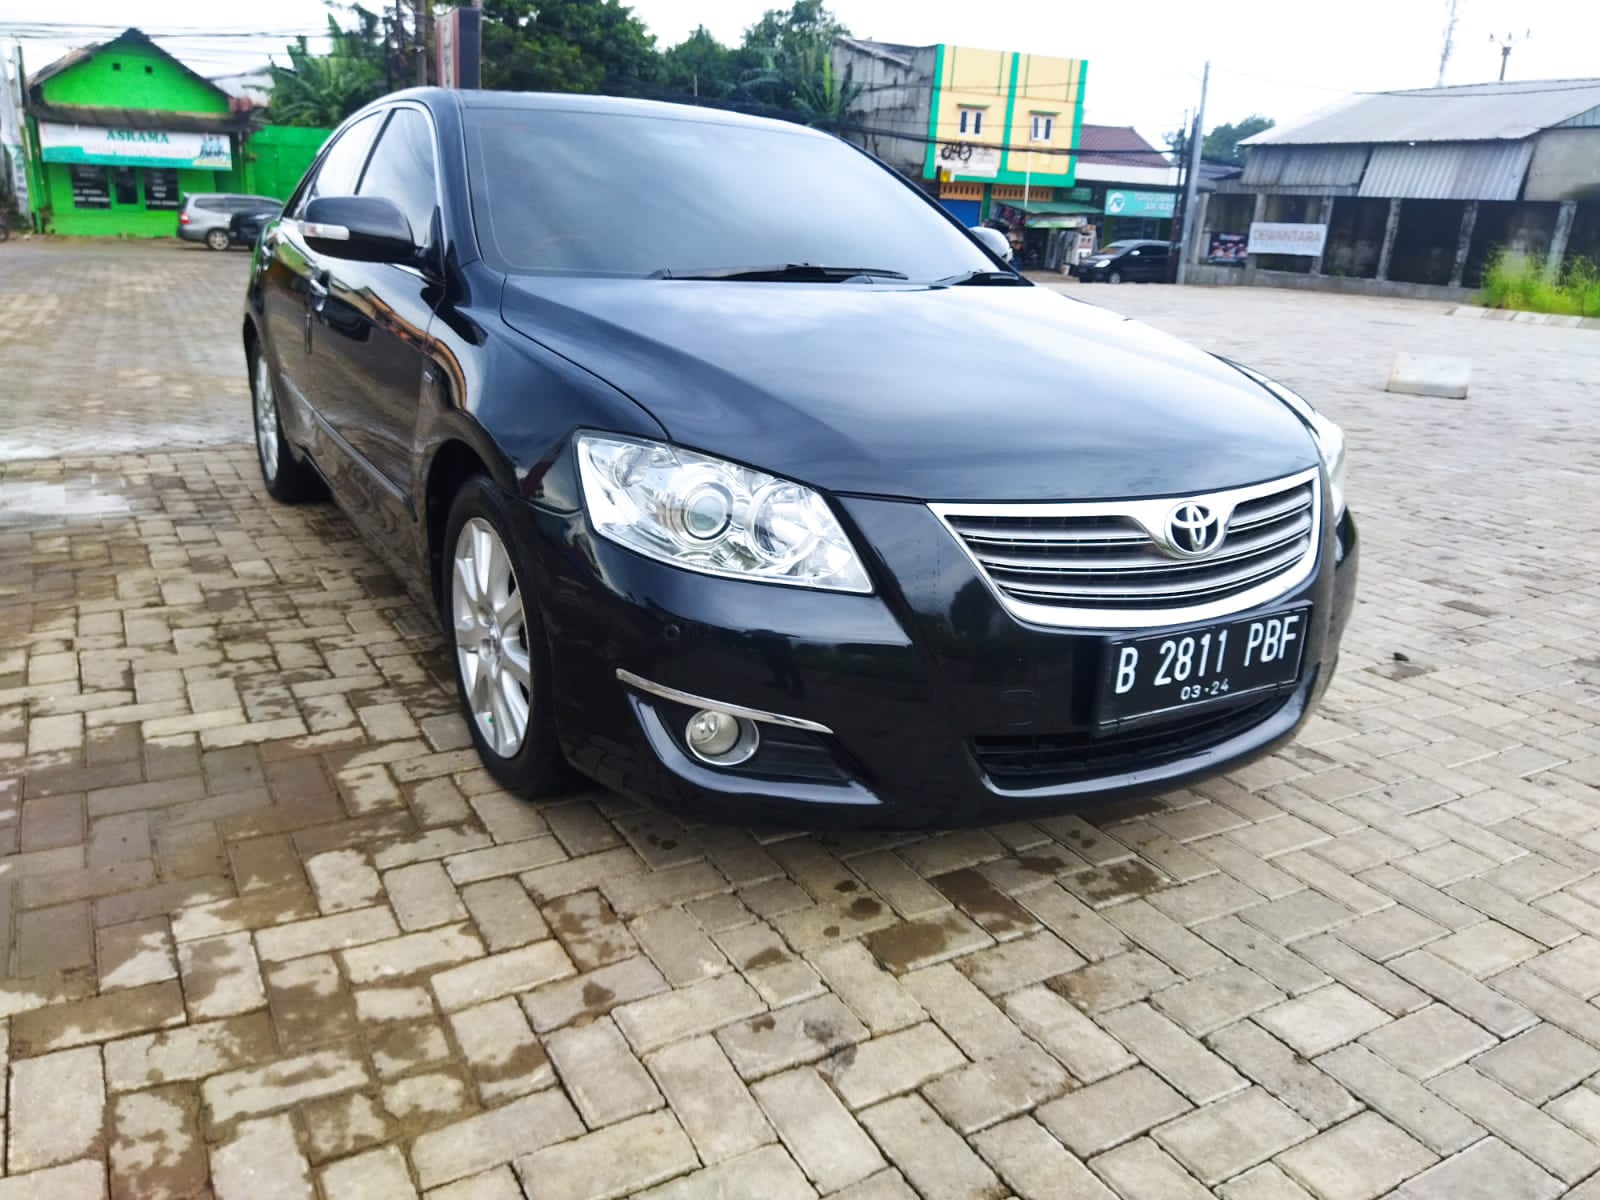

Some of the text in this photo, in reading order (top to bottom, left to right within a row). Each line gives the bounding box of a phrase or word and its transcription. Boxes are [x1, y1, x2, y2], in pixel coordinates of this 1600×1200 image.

[1115, 615, 1300, 694] B 2811 PBF
